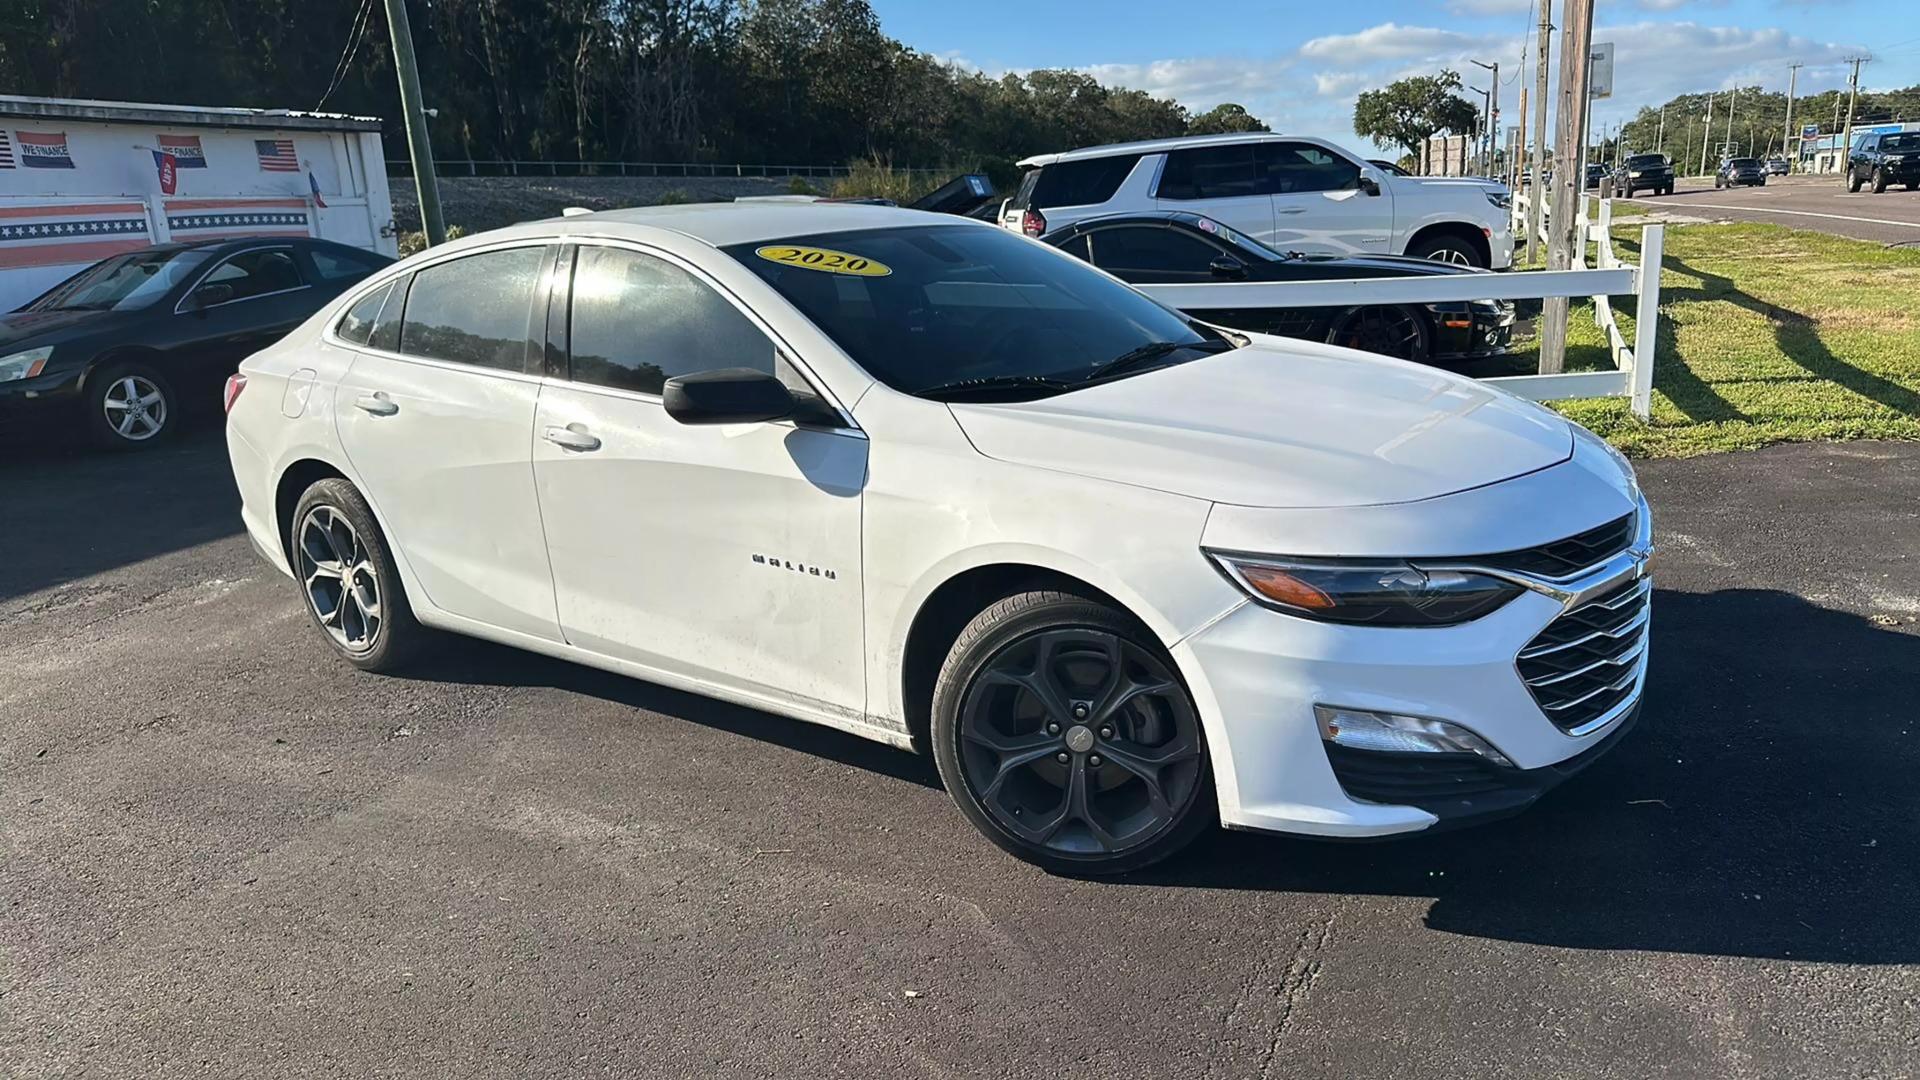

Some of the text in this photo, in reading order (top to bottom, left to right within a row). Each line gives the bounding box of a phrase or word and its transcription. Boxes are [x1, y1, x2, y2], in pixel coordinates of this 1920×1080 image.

[21, 144, 69, 156] WE FINANCE
[174, 146, 202, 157] FINANCE
[778, 249, 868, 270] 2020
[752, 554, 836, 580] MALIBU
